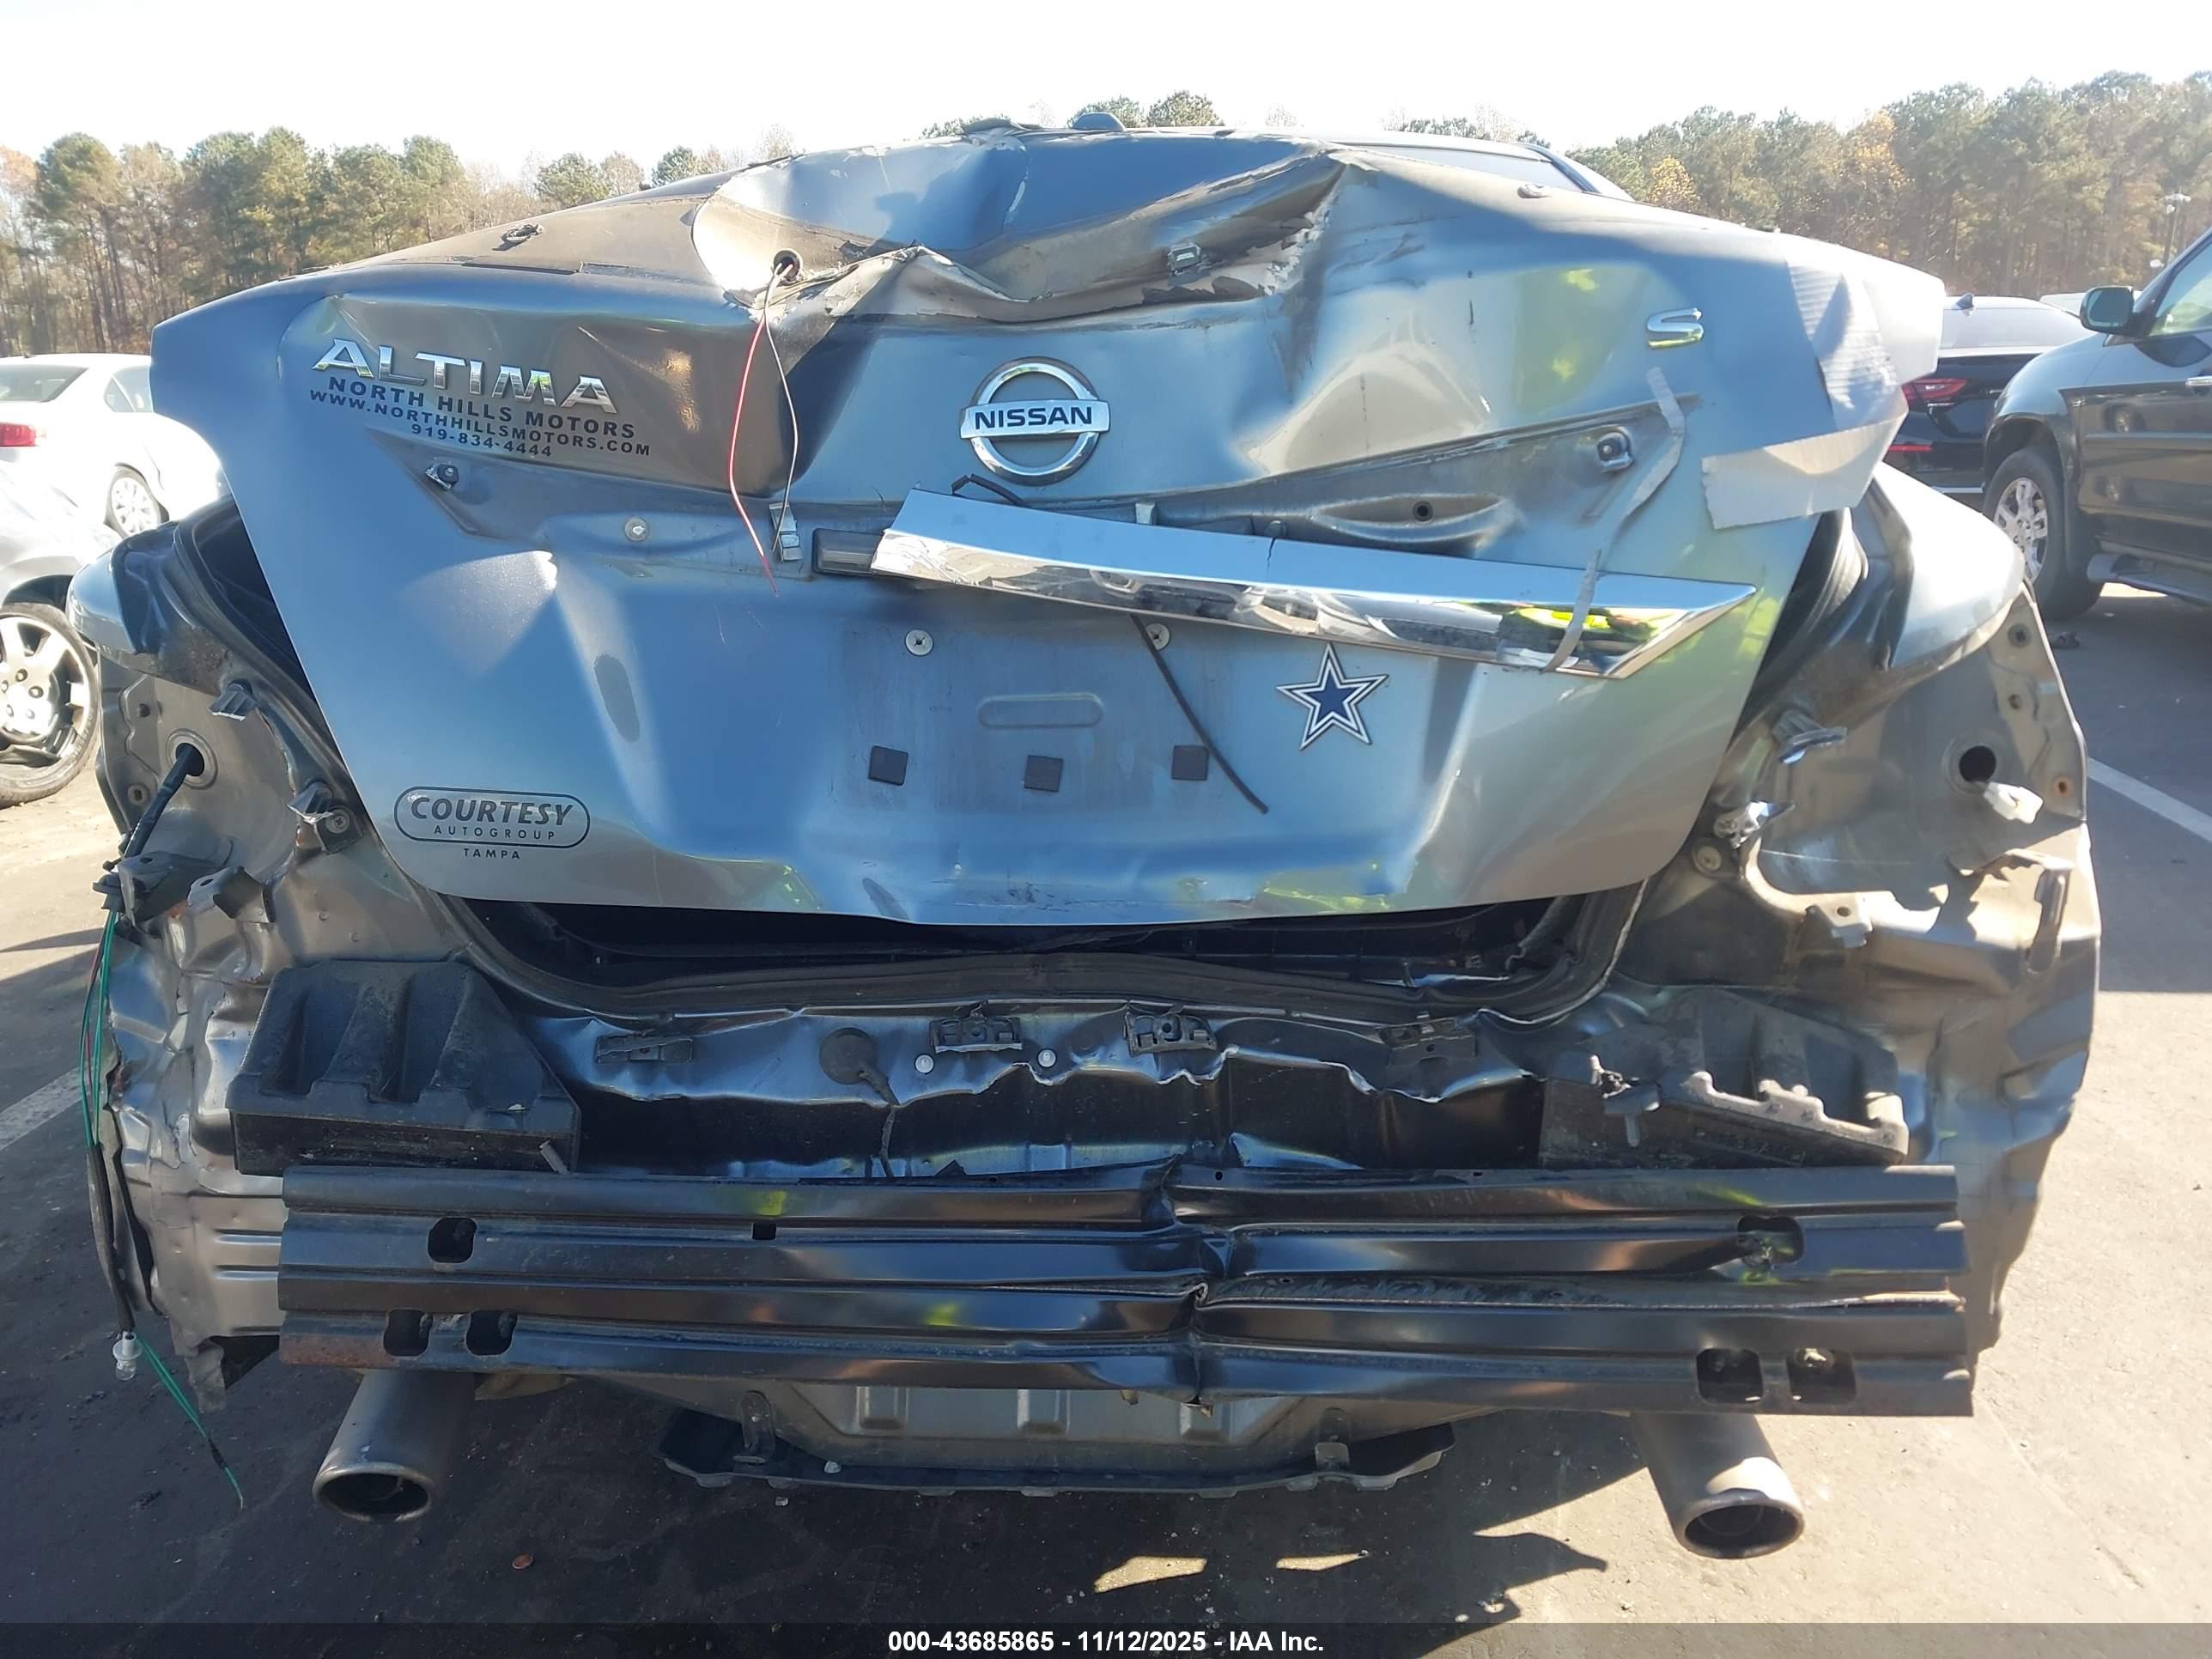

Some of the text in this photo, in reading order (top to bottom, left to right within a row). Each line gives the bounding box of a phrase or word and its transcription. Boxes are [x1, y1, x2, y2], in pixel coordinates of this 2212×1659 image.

[1647, 307, 1704, 349] S
[311, 337, 618, 414] ALTIMA
[309, 390, 651, 457] WWW.NORTHHILLSMOTORS.COM
[329, 376, 635, 439] NORTH HILLS MOTORS
[975, 407, 1092, 430] NISSAN
[410, 423, 552, 458] 919-834-4444
[410, 797, 574, 826] COURTESY
[434, 824, 556, 841] AUTOGROUP
[463, 848, 520, 860] TAMPA
